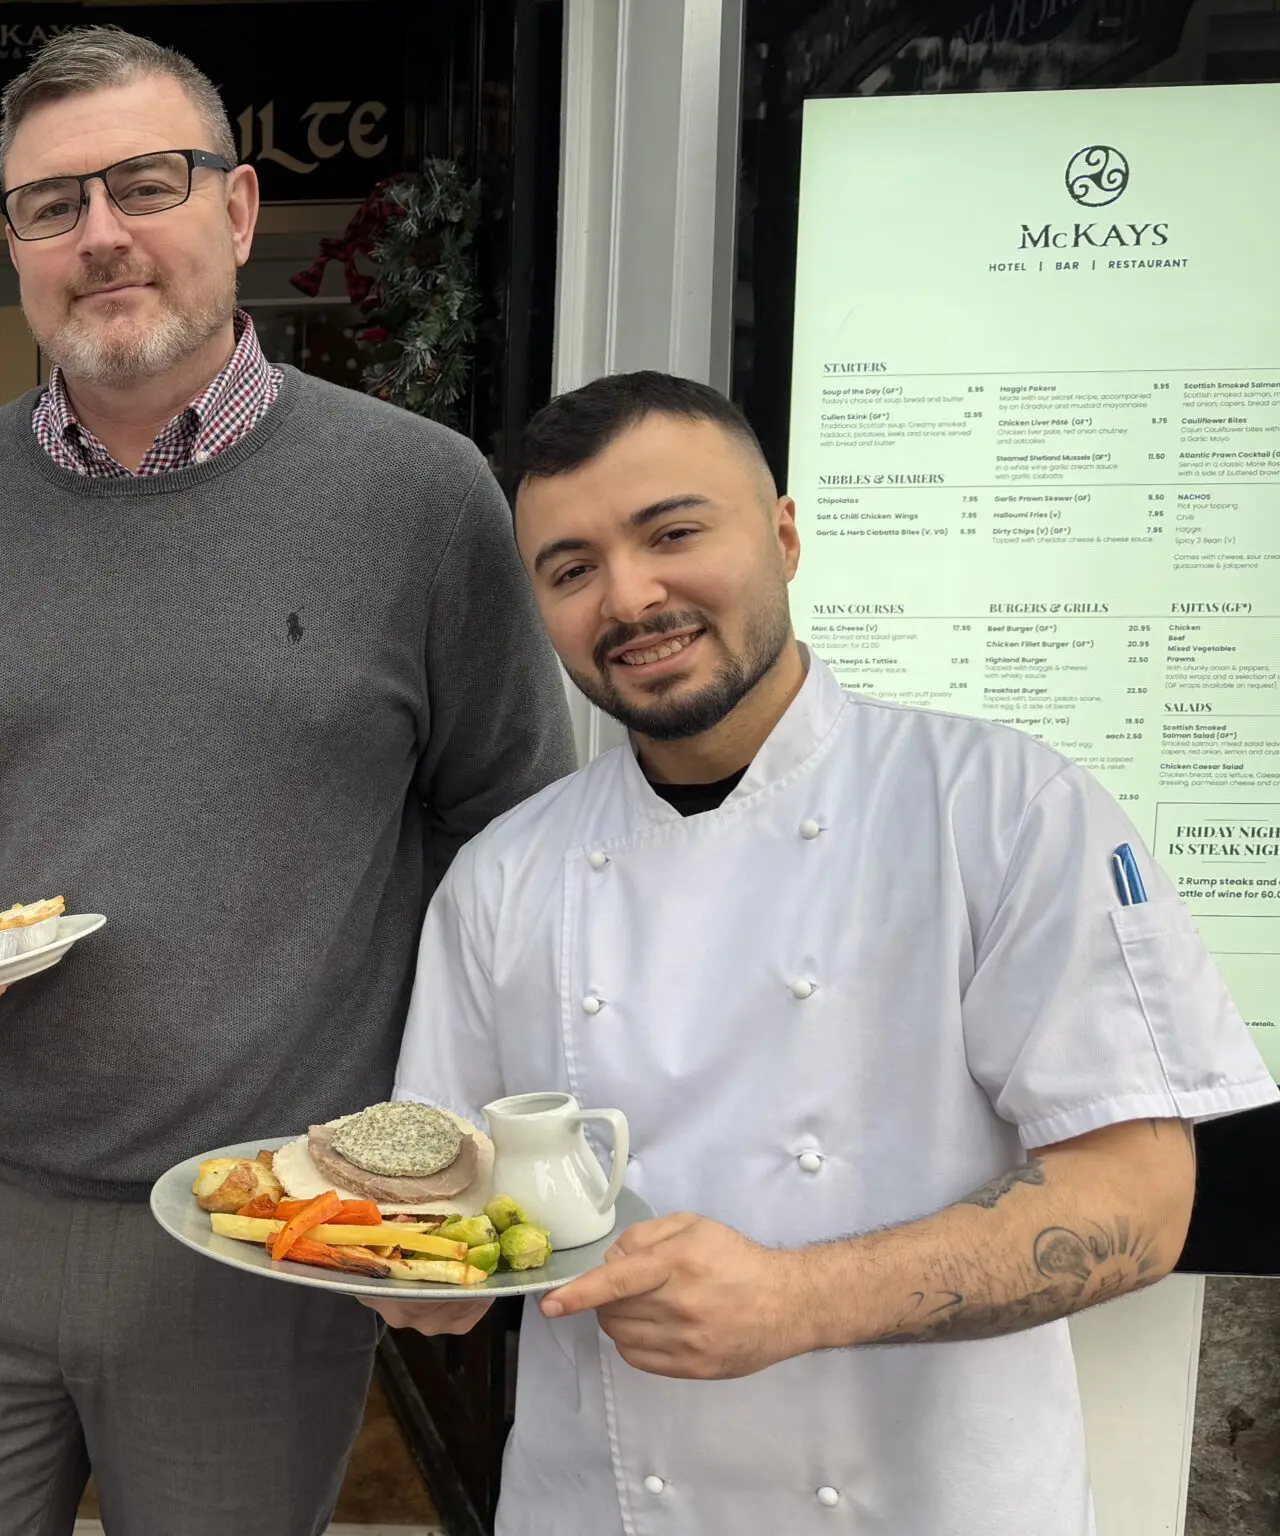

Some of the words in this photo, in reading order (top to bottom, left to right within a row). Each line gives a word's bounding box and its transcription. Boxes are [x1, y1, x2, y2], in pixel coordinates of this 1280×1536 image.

[1018, 223, 1168, 250] McKAYS
[988, 262, 1027, 272] HOTEL
[1056, 261, 1079, 270] BAR
[1108, 258, 1188, 269] RESTAURANT
[823, 362, 887, 373] STARTERS
[819, 475, 871, 484] NIBBLES
[873, 474, 884, 484] &
[887, 474, 944, 484] SHARERS
[813, 604, 846, 614] MAIN
[848, 604, 905, 614] COURSES
[989, 603, 1047, 613] BURGERS
[1050, 603, 1061, 613] &
[1064, 603, 1109, 613] GRILLS
[1171, 602, 1219, 614] FAJITAS
[1006, 625, 1033, 634] Burger
[1042, 641, 1069, 650] Burger
[1164, 702, 1213, 712] SALADS
[1176, 826, 1234, 838] FRIDAY
[1239, 826, 1280, 839] NIGH
[1168, 844, 1184, 855] IS
[1188, 844, 1241, 856] STEAK
[1244, 844, 1280, 856] NIG
[1178, 877, 1184, 885] 2
[1187, 877, 1217, 887] Rump
[1220, 878, 1253, 886] steaks
[1256, 878, 1277, 886] and
[1179, 890, 1203, 898] ottle
[1205, 890, 1215, 898] of
[1218, 890, 1242, 898] wine
[1245, 890, 1259, 898] for
[1261, 890, 1280, 898] 60.
